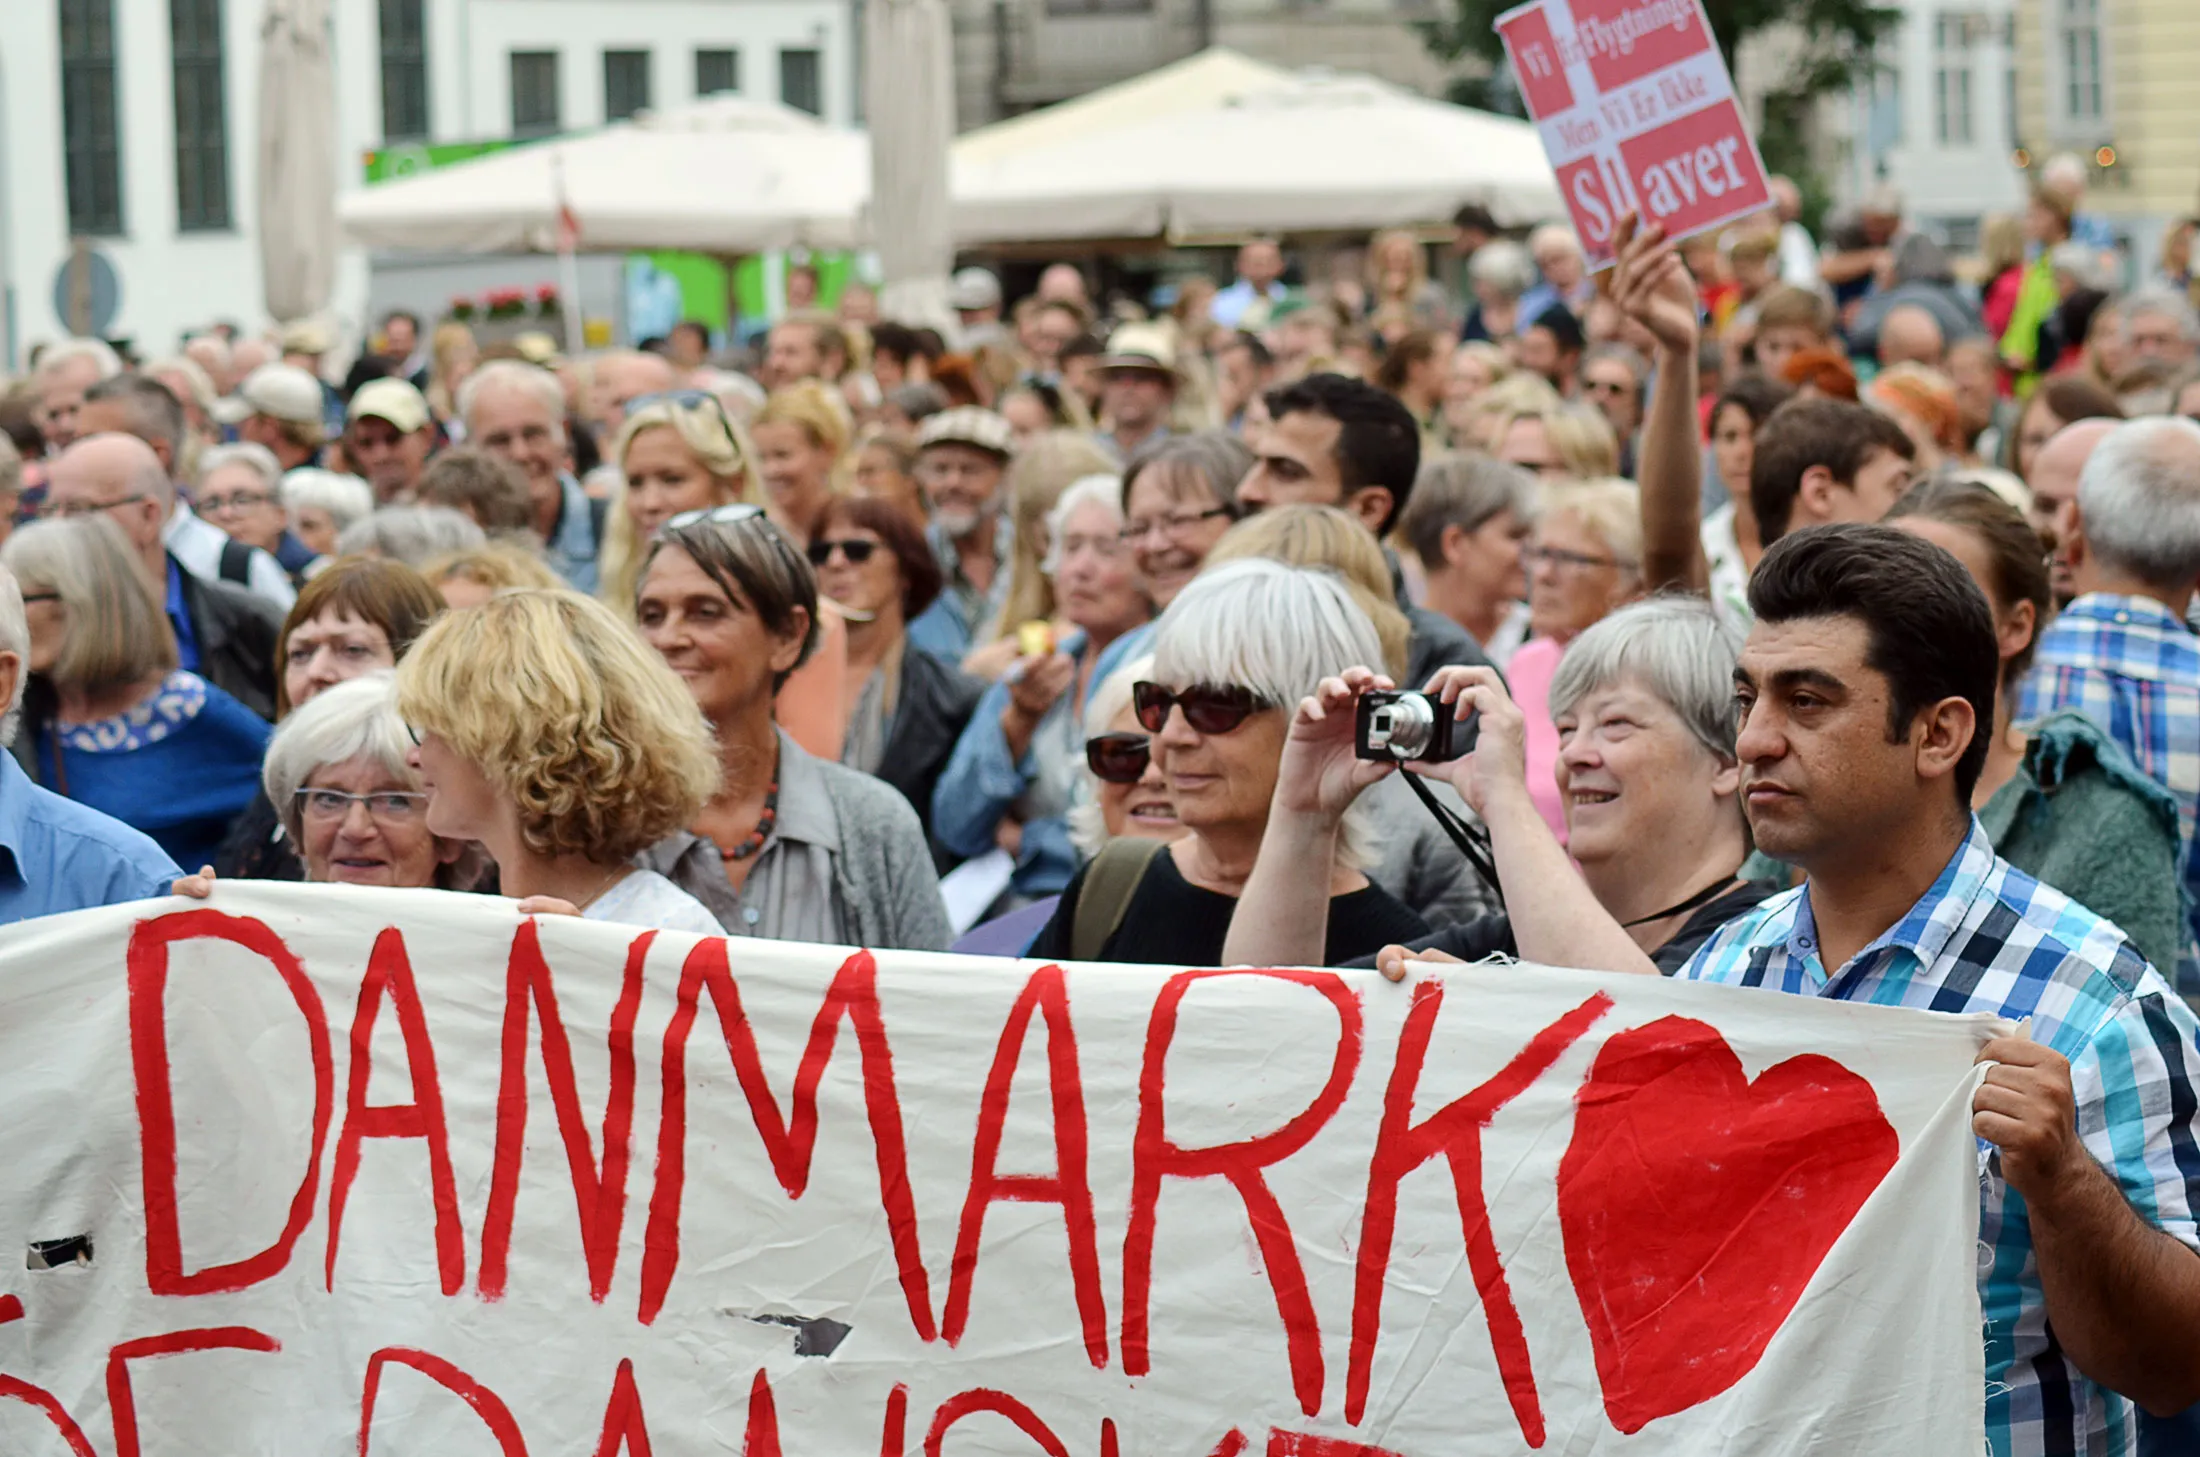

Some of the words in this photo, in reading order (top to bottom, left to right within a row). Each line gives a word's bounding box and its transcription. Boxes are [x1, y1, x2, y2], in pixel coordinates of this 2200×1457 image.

[1520, 40, 1553, 79] Vi
[1556, 118, 1602, 151] Men
[1600, 96, 1631, 131] Vi
[1628, 88, 1660, 124] Er
[1658, 70, 1708, 111] Ikke
[127, 909, 1616, 1449] DANMARK
